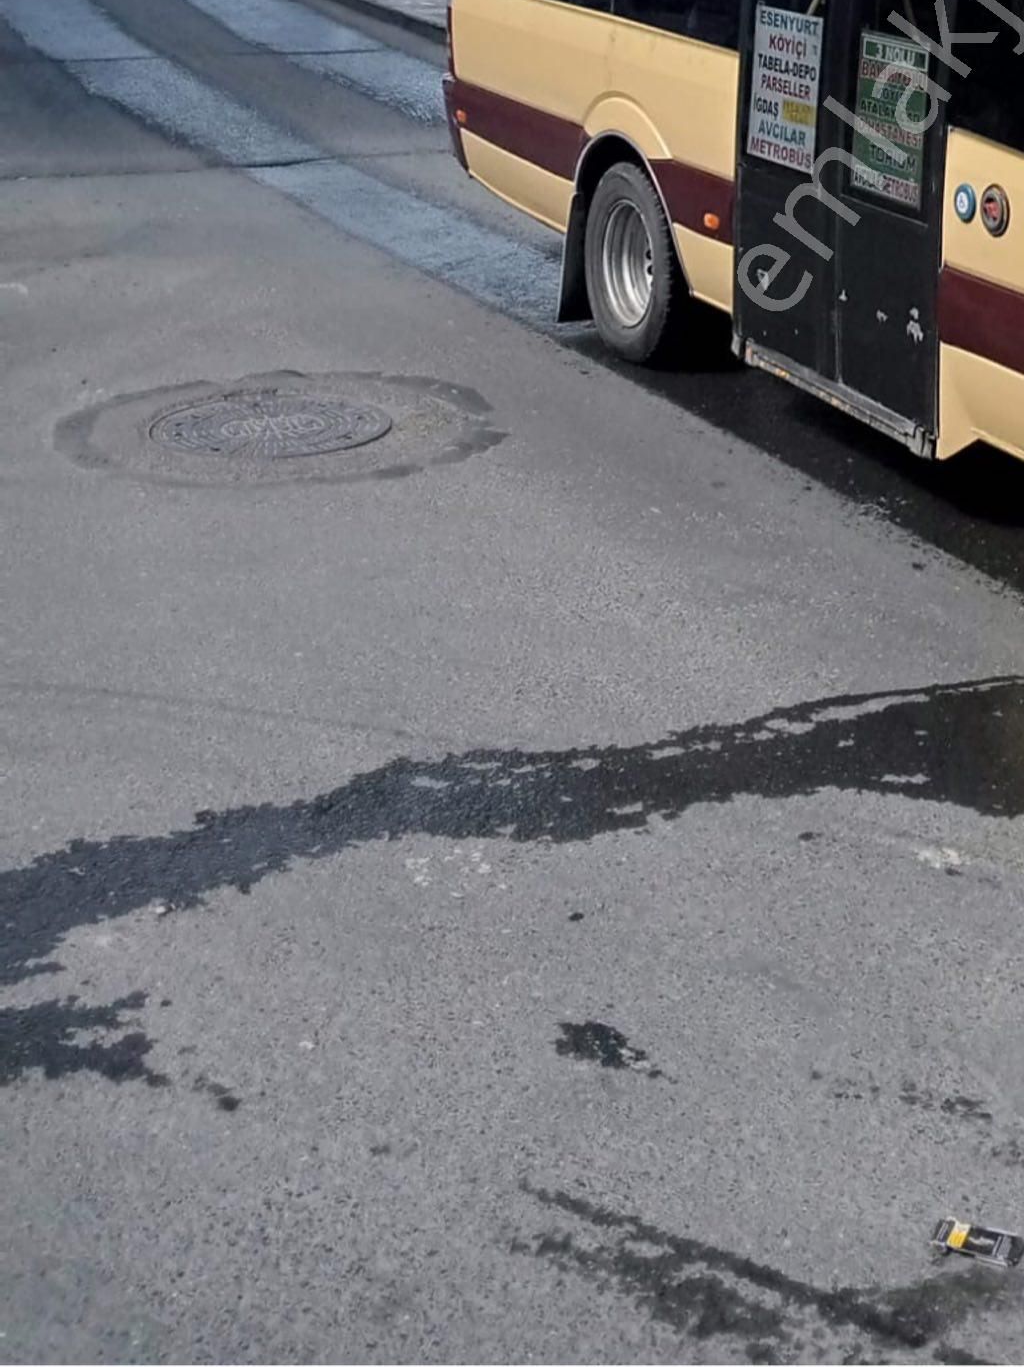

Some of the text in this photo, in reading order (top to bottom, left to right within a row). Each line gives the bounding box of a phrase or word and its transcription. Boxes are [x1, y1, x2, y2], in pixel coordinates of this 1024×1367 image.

[760, 10, 819, 36] ESENYURT
[768, 33, 807, 59] KÖYİÇİ
[876, 43, 884, 60] 3
[758, 53, 817, 81] TABELA-DEPO
[761, 74, 811, 100] PARSELLER
[758, 119, 806, 147] AVCILAR
[750, 136, 812, 169] METROBÜS
